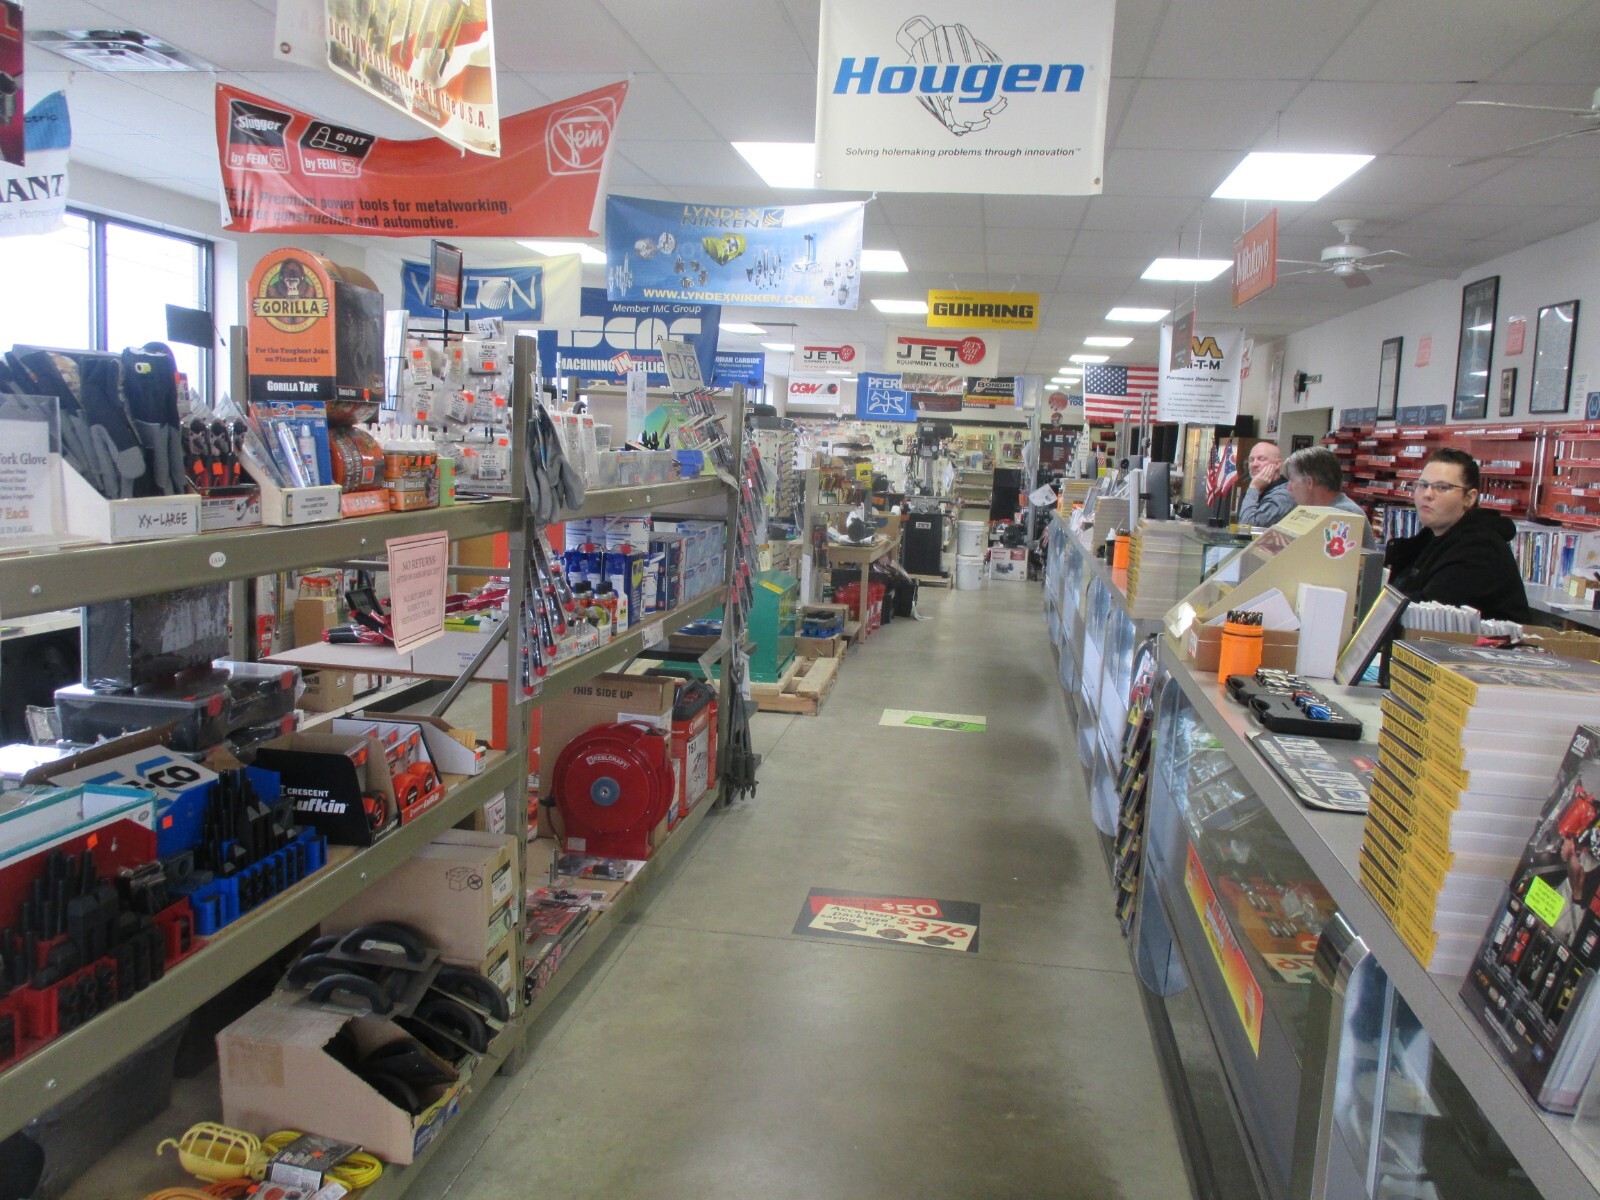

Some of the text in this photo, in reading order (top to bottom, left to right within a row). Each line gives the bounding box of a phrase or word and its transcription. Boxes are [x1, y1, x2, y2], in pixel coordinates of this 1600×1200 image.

[361, 36, 425, 96] Manufactured
[429, 84, 438, 104] in
[440, 91, 457, 115] the
[459, 102, 491, 129] U.S.A.
[832, 57, 1085, 104] Hougen
[24, 114, 57, 123] ctric
[238, 116, 282, 131] Slugger
[335, 133, 367, 146] GRIT
[231, 152, 268, 165] by FEIN
[845, 147, 1075, 157] Solving holemaking problems through innovation
[305, 158, 336, 170] by FEIN
[0, 174, 65, 203] ANT
[260, 191, 317, 206] Premium
[321, 198, 355, 211] power
[360, 198, 390, 212] tools
[392, 199, 412, 212] for
[415, 198, 512, 216] metalworking,
[683, 205, 760, 219] LYNDEX
[273, 211, 353, 226] construction
[357, 215, 379, 228] and
[383, 216, 458, 230] automotive.
[681, 216, 760, 229] NIKKEN
[1236, 239, 1269, 286] Mitutoyo
[262, 301, 320, 314] GORILLA
[612, 303, 702, 316] Member IMC Group
[933, 302, 1034, 318] GUHRING
[803, 350, 840, 360] JET
[896, 344, 958, 362] JET
[559, 357, 614, 372] MACHINING
[612, 351, 634, 375] IN
[631, 361, 667, 374] TELLIG
[267, 380, 318, 392] GORILLA TAPE
[789, 382, 823, 394] CGW
[867, 376, 902, 389] PFER
[1043, 434, 1075, 443] JET
[0, 452, 48, 465] ork Glove
[138, 512, 188, 528] XX-LARGE
[401, 555, 436, 572] NO RETURNS
[573, 686, 633, 700] THIS SIDE UP
[287, 787, 330, 797] CRESCENT
[830, 906, 898, 921] Accessory
[881, 902, 938, 916] $50
[820, 914, 863, 925] savings
[832, 911, 889, 925] package
[897, 917, 969, 938] $376
